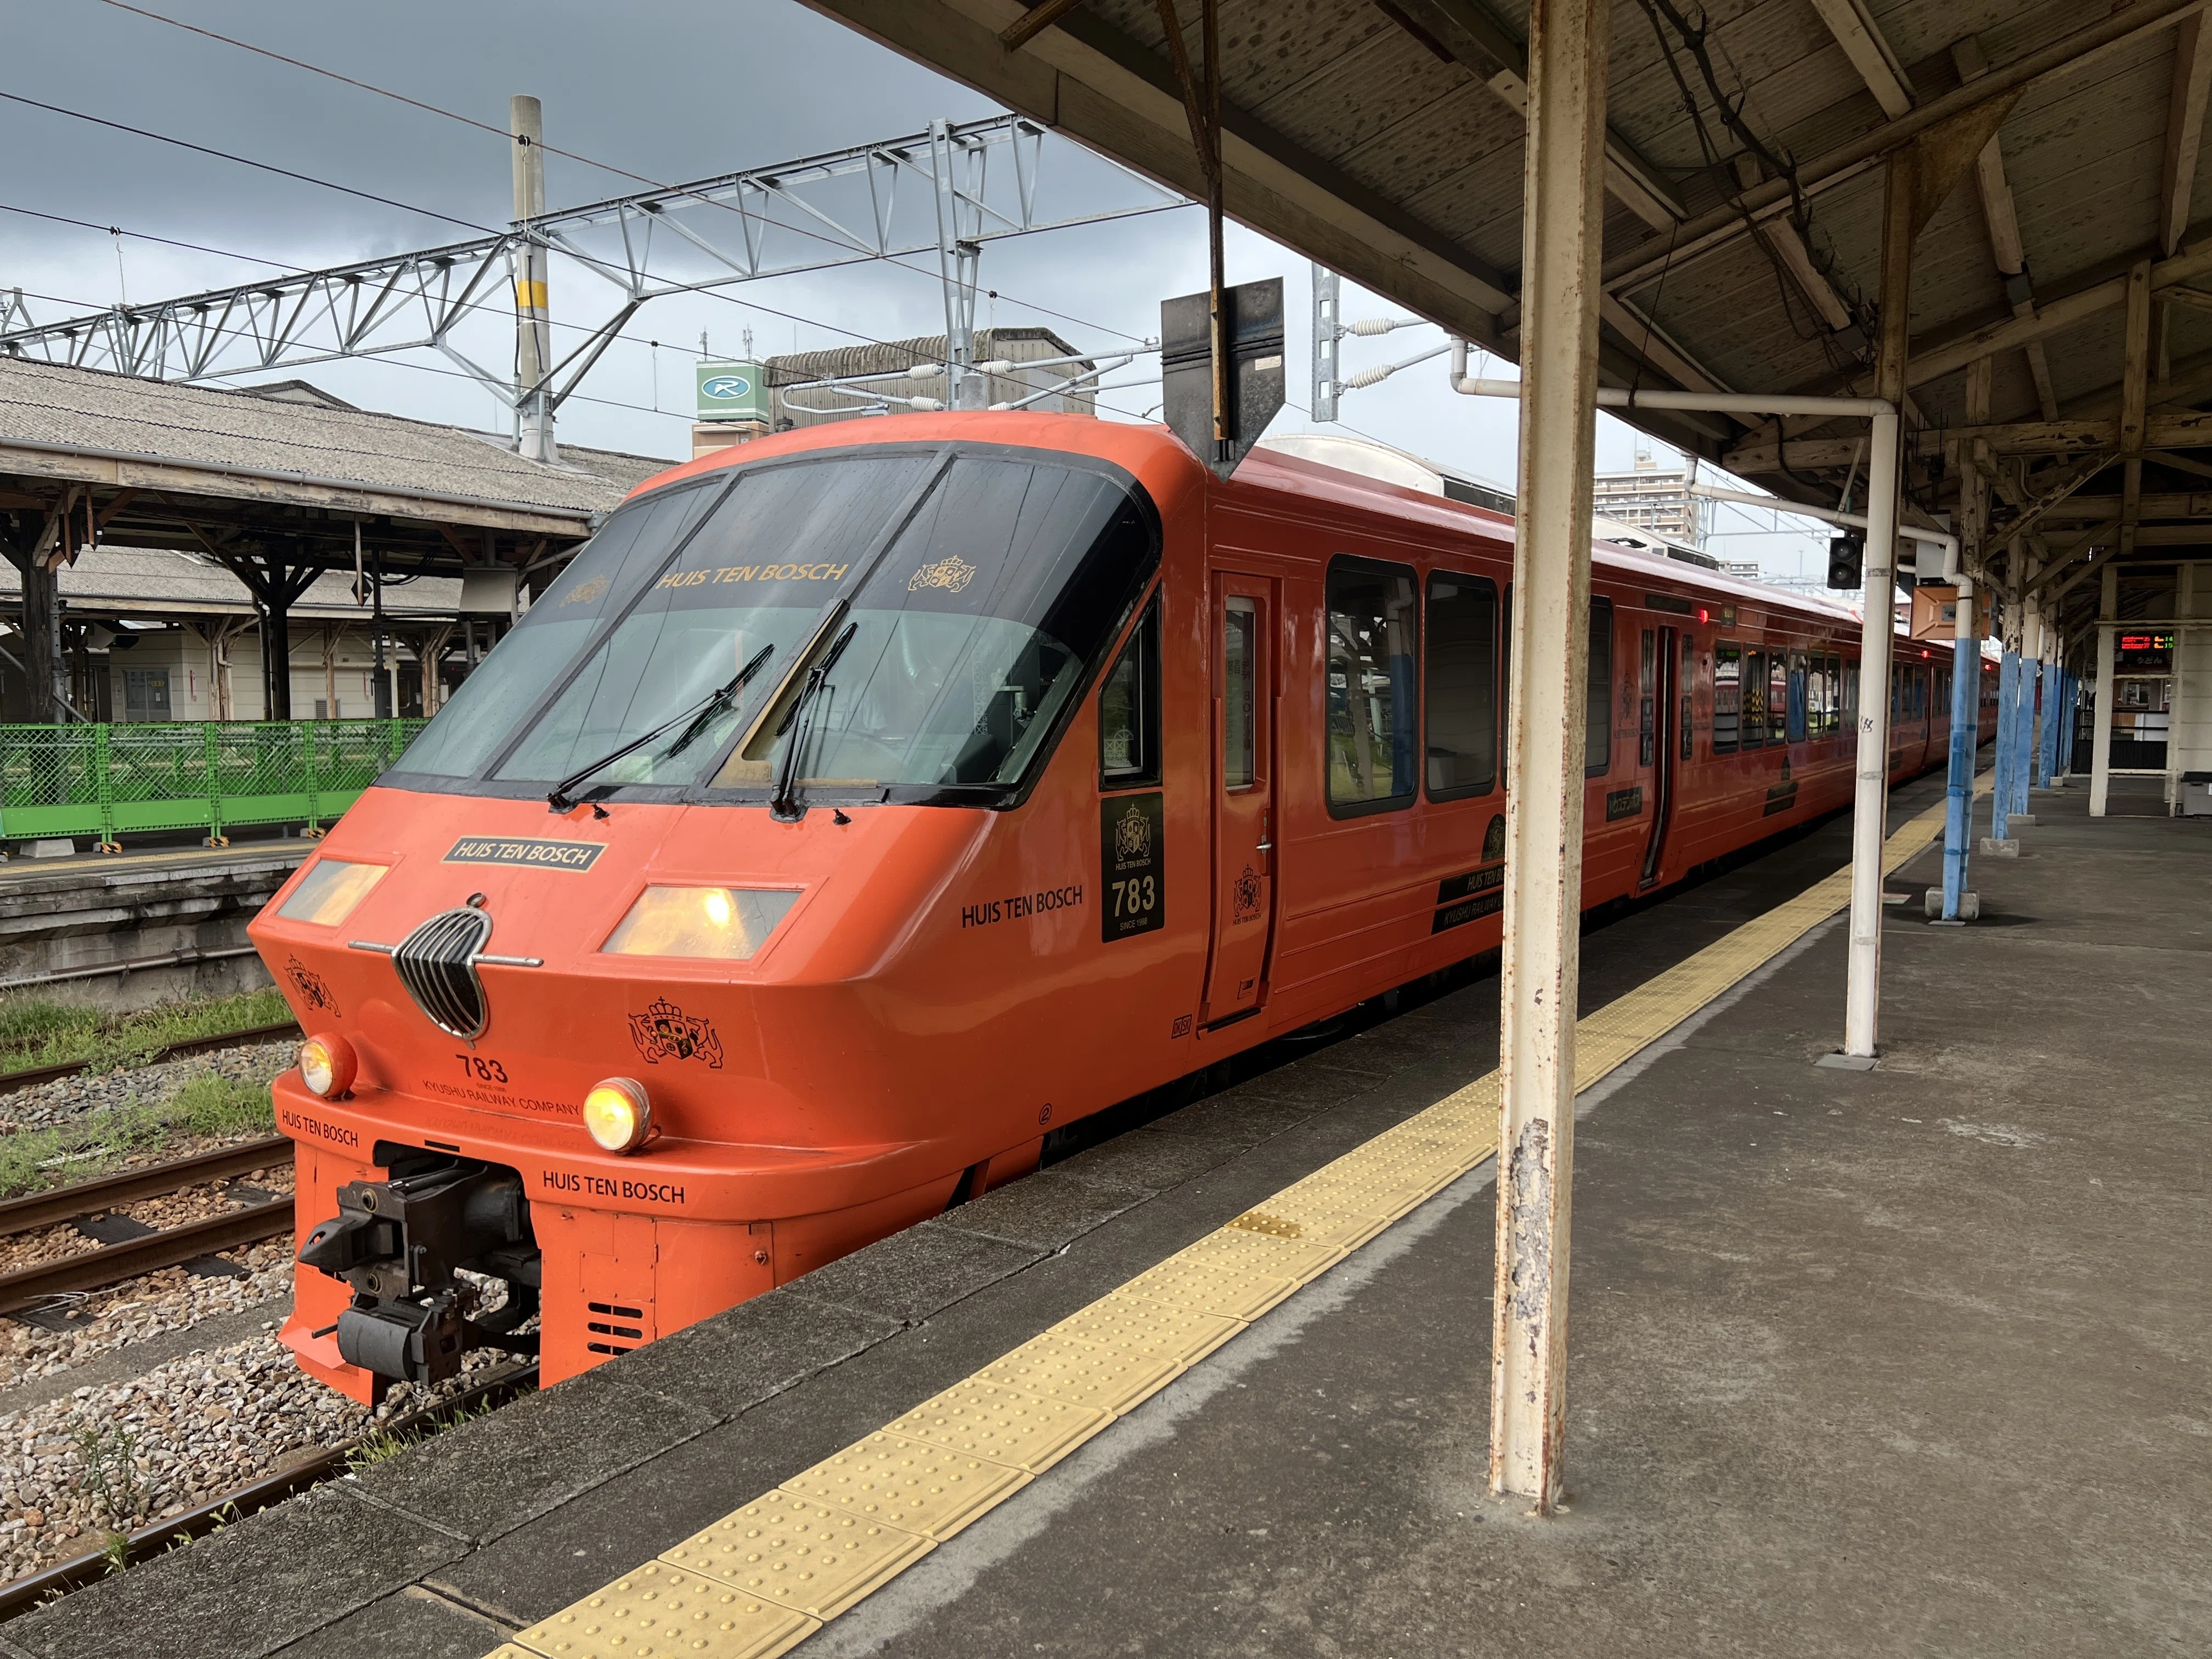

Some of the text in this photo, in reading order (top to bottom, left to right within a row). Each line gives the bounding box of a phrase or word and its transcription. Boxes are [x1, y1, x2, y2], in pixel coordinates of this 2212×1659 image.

[655, 564, 849, 589] HUIS TEN BOSCH
[454, 842, 592, 865] HUIS TEN BOSCH
[1115, 857, 1152, 871] HUIS TEN BOSCH
[1467, 874, 1484, 891] HUIS
[1483, 868, 1498, 886] TEN
[962, 884, 1083, 928] HUIS TEN BOSCH
[1112, 875, 1155, 917] 783
[1120, 919, 1136, 931] SINCE
[1443, 904, 1472, 926] KYUSHU
[455, 1054, 508, 1084] 783
[422, 1080, 579, 1116] KYUSHU RAILWAY COMPANY
[1041, 1107, 1049, 1122] 2
[282, 1109, 358, 1148] HUIS TEN BOSCH
[543, 1170, 684, 1204] HUIS TEN BOSCH
